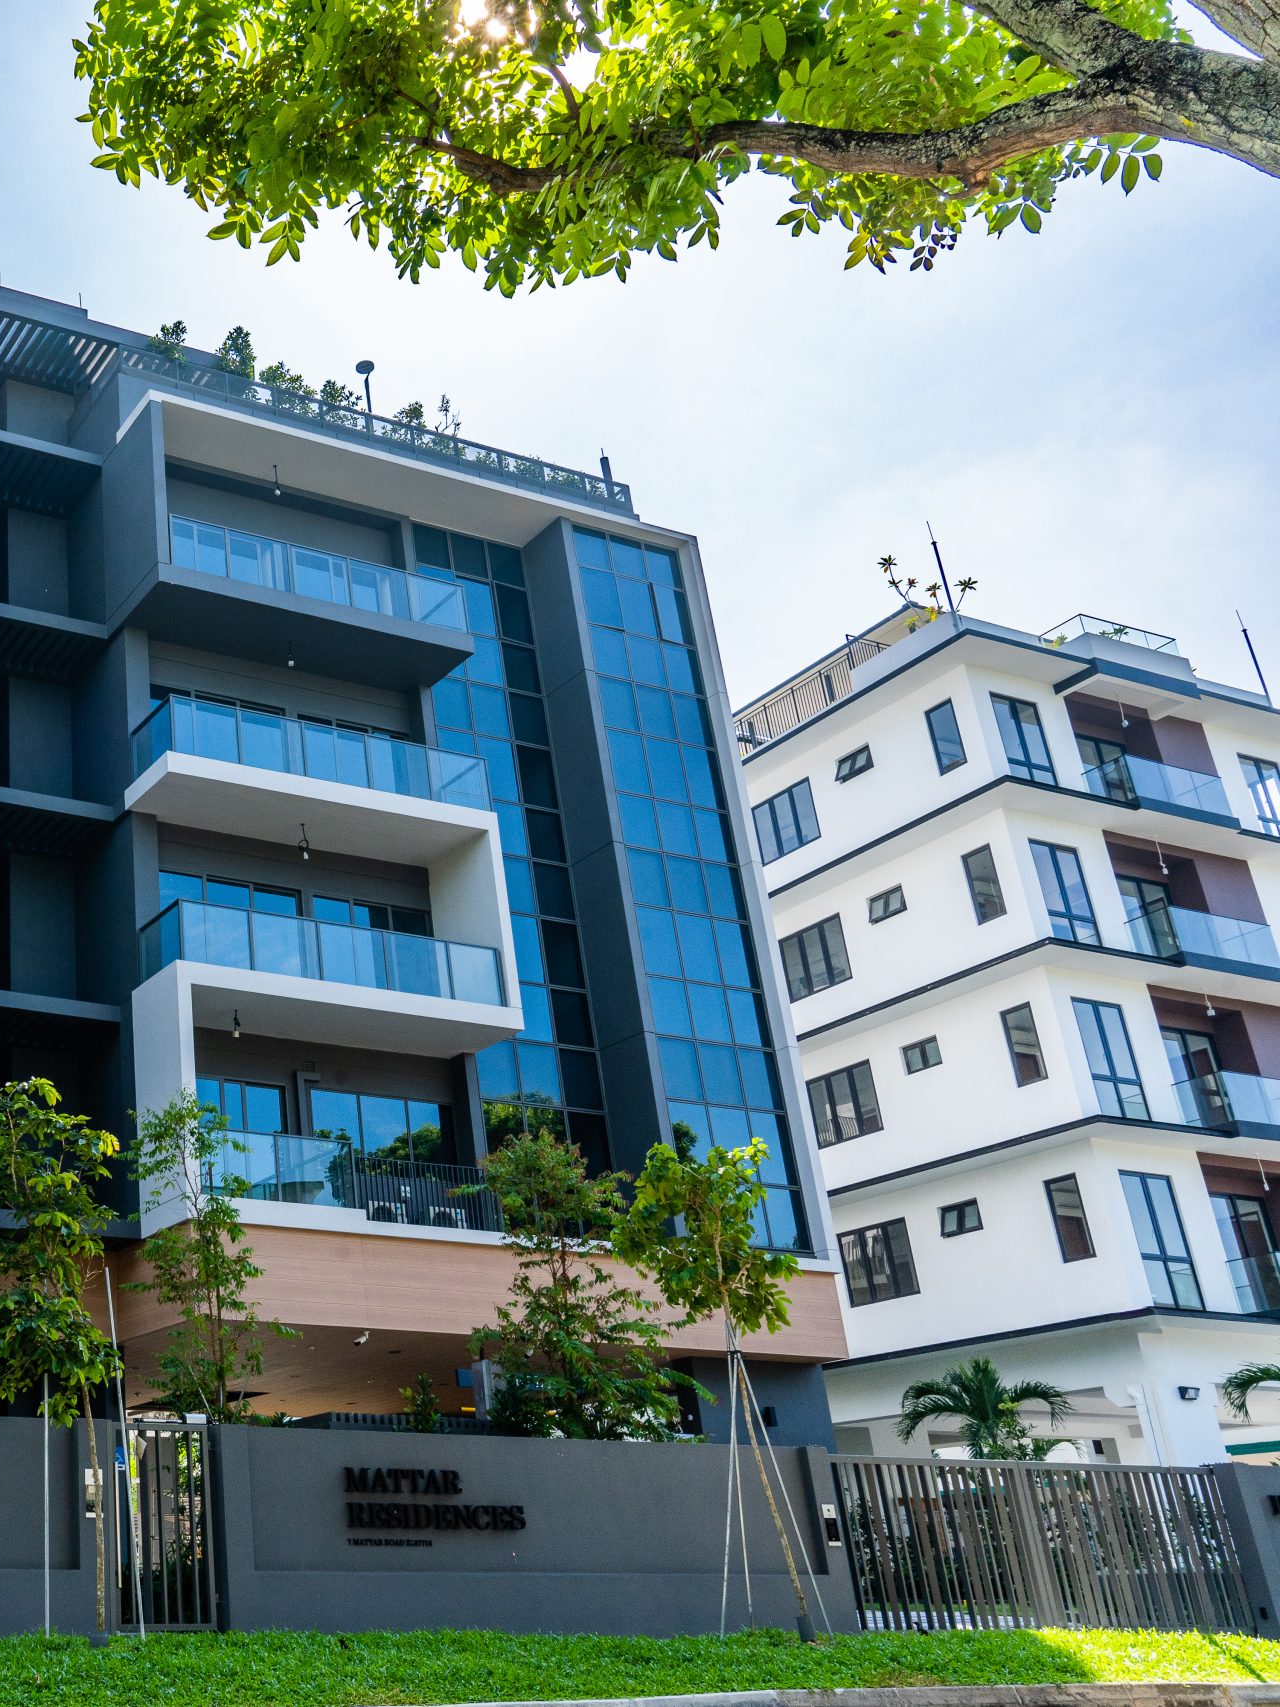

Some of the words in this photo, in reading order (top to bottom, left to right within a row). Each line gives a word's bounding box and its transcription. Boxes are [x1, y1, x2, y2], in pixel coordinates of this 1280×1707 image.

[343, 1467, 463, 1494] MATTAR
[346, 1502, 527, 1530] RESIDENCES
[352, 1538, 383, 1546] MATTAR
[384, 1539, 405, 1547] ROAD
